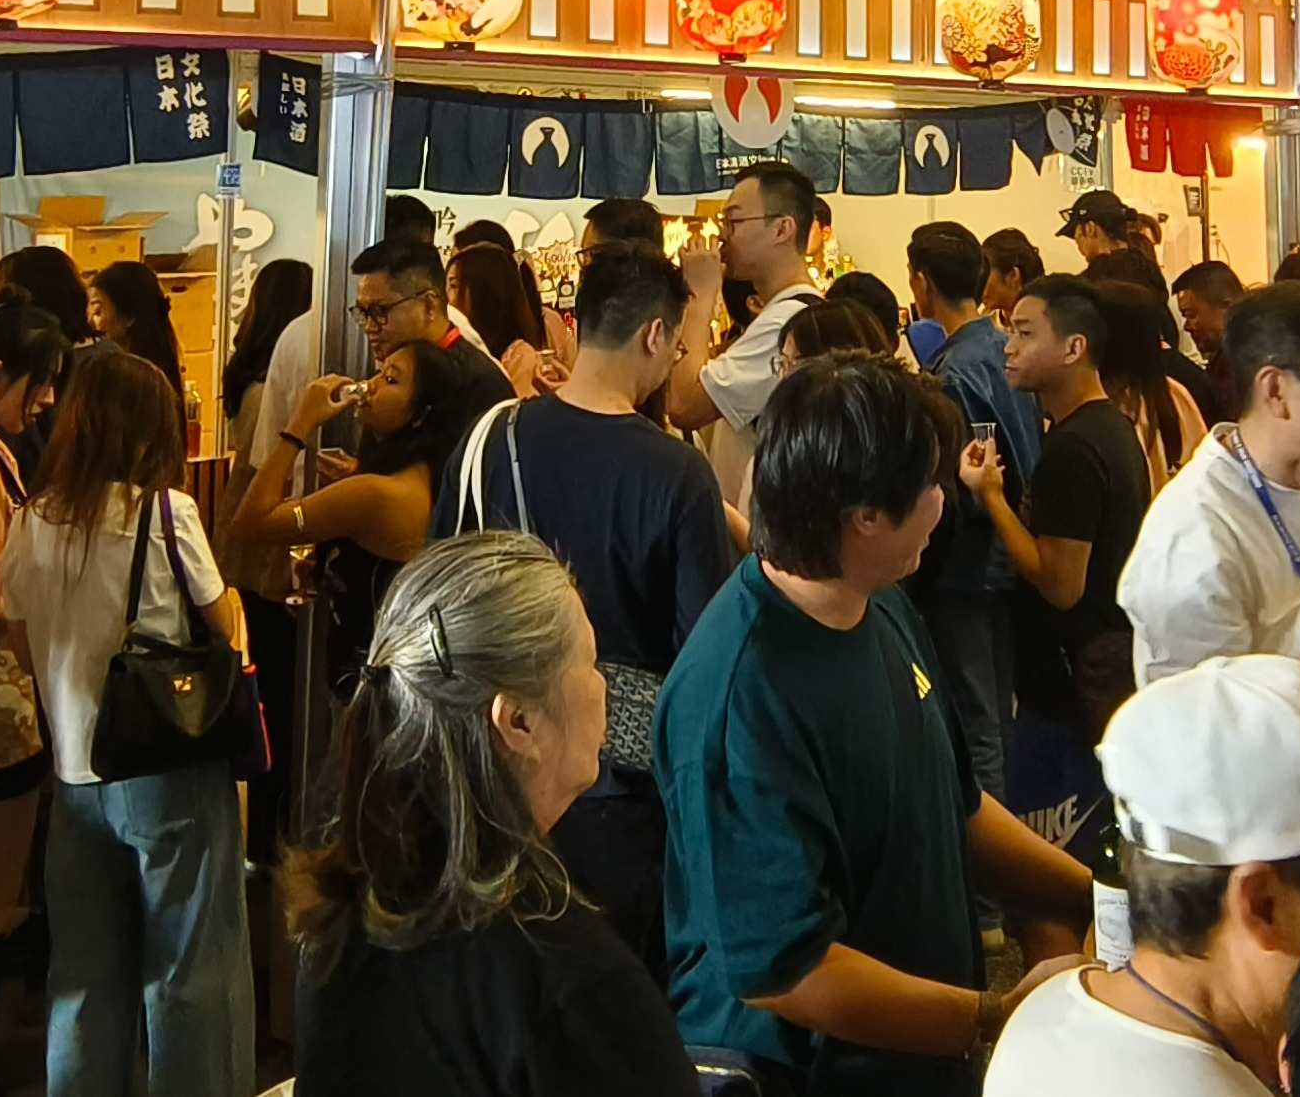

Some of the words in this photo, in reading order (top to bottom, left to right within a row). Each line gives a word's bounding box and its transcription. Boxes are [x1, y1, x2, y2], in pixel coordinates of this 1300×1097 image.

[155, 53, 180, 112] 日本
[180, 52, 211, 140] 文化祭
[289, 75, 309, 143] 日本酒
